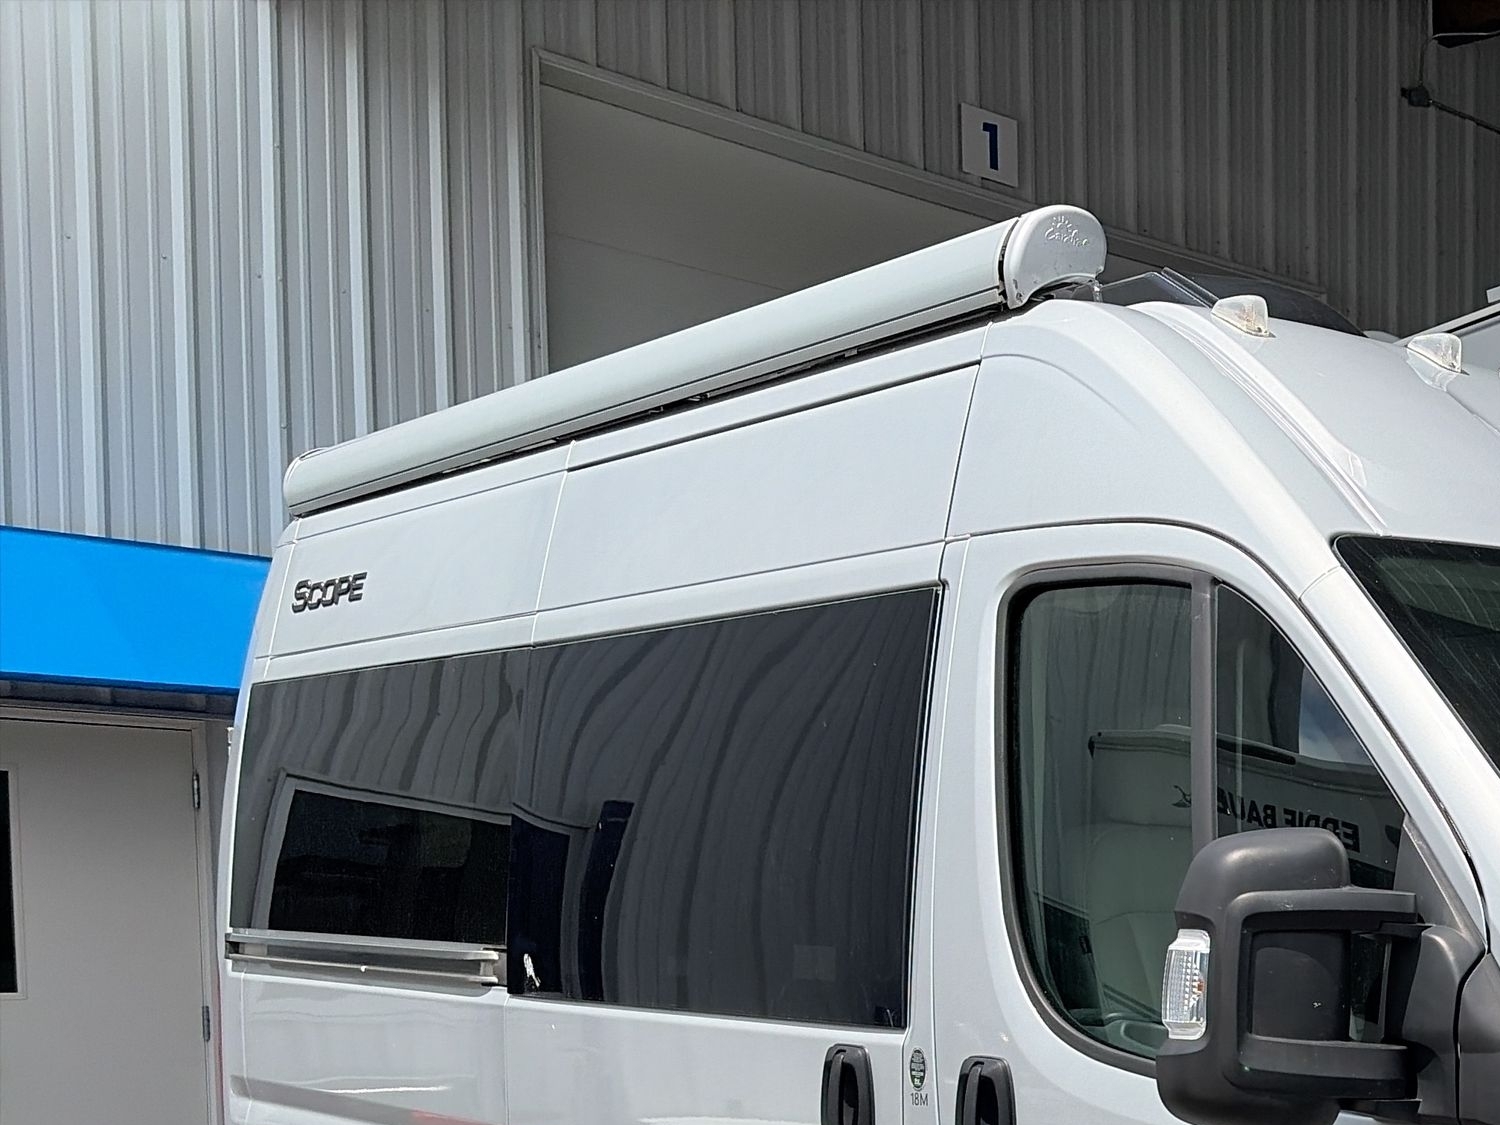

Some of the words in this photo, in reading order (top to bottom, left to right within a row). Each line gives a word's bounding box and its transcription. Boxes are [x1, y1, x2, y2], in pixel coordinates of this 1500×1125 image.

[982, 121, 999, 171] 1
[292, 571, 367, 613] SCOPE
[910, 1092, 929, 1107] 18M
